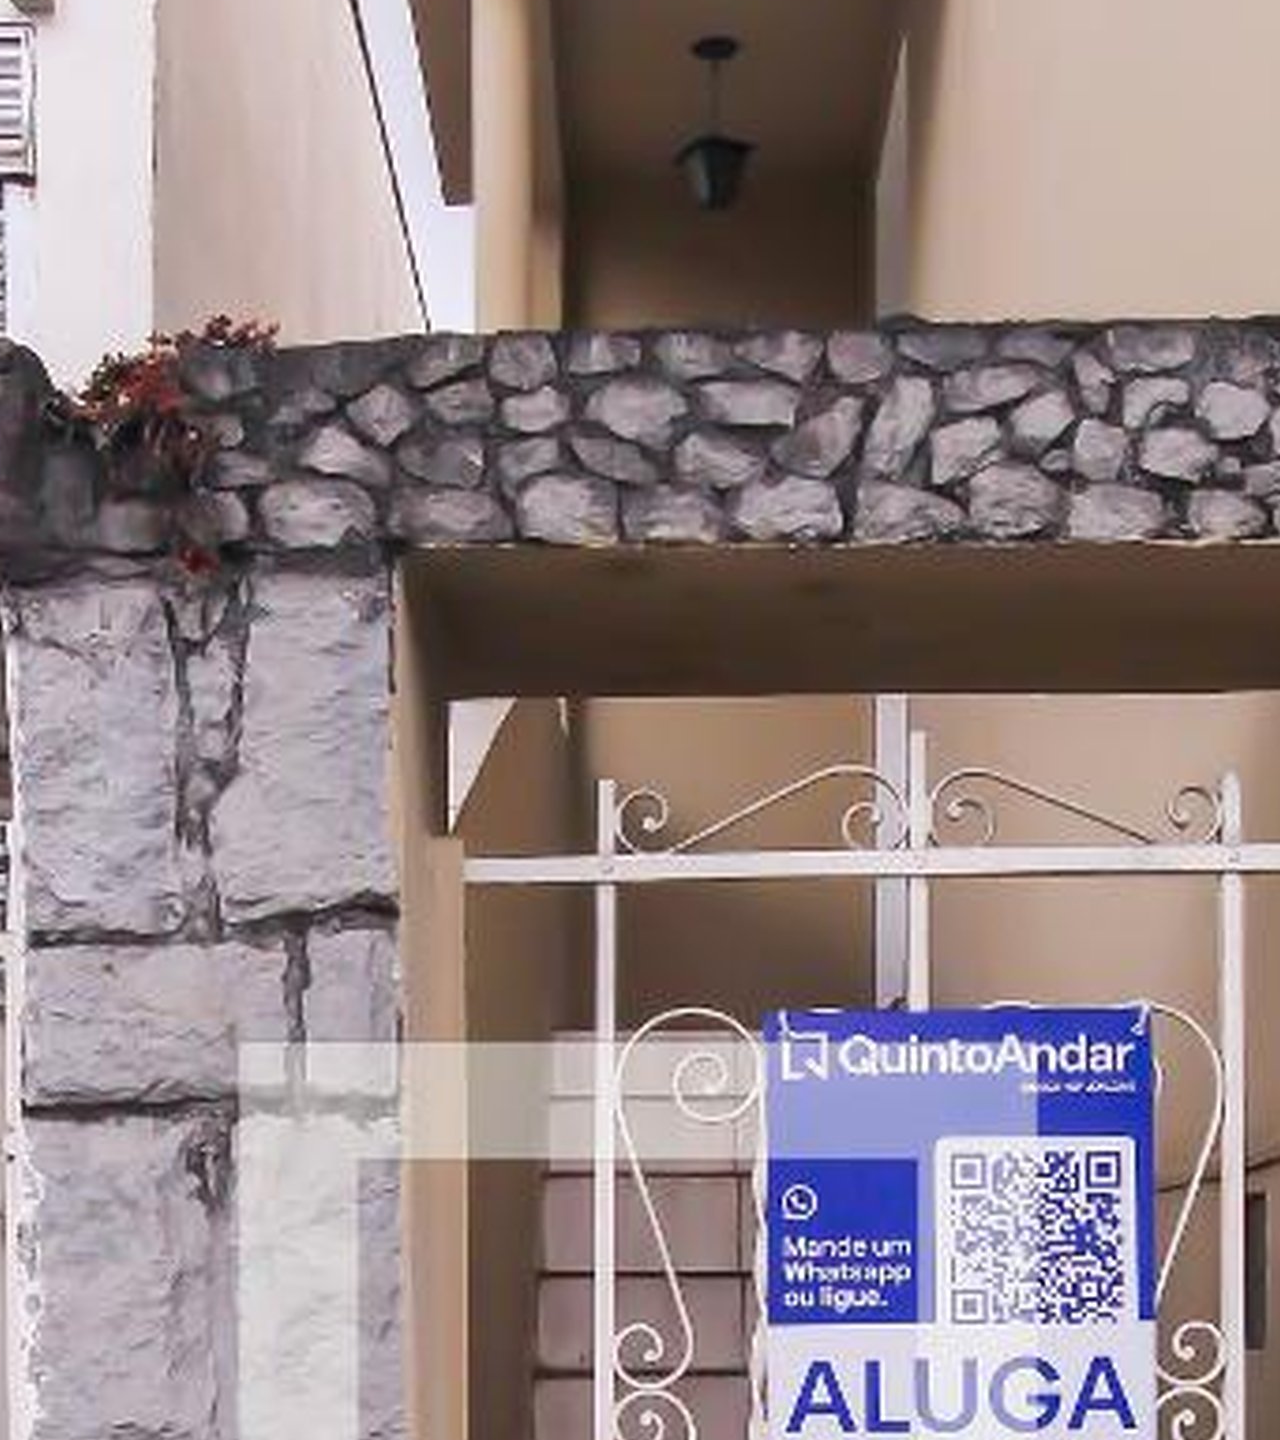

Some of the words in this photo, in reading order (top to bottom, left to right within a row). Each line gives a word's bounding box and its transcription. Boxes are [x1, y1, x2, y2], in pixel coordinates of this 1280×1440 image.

[838, 1033, 1136, 1077] QuintoAndar
[783, 1236, 867, 1258] Mande
[871, 1240, 912, 1257] um
[783, 1290, 815, 1307] ou
[819, 1285, 889, 1314] ligue.
[785, 1356, 1138, 1433] ALUGA
